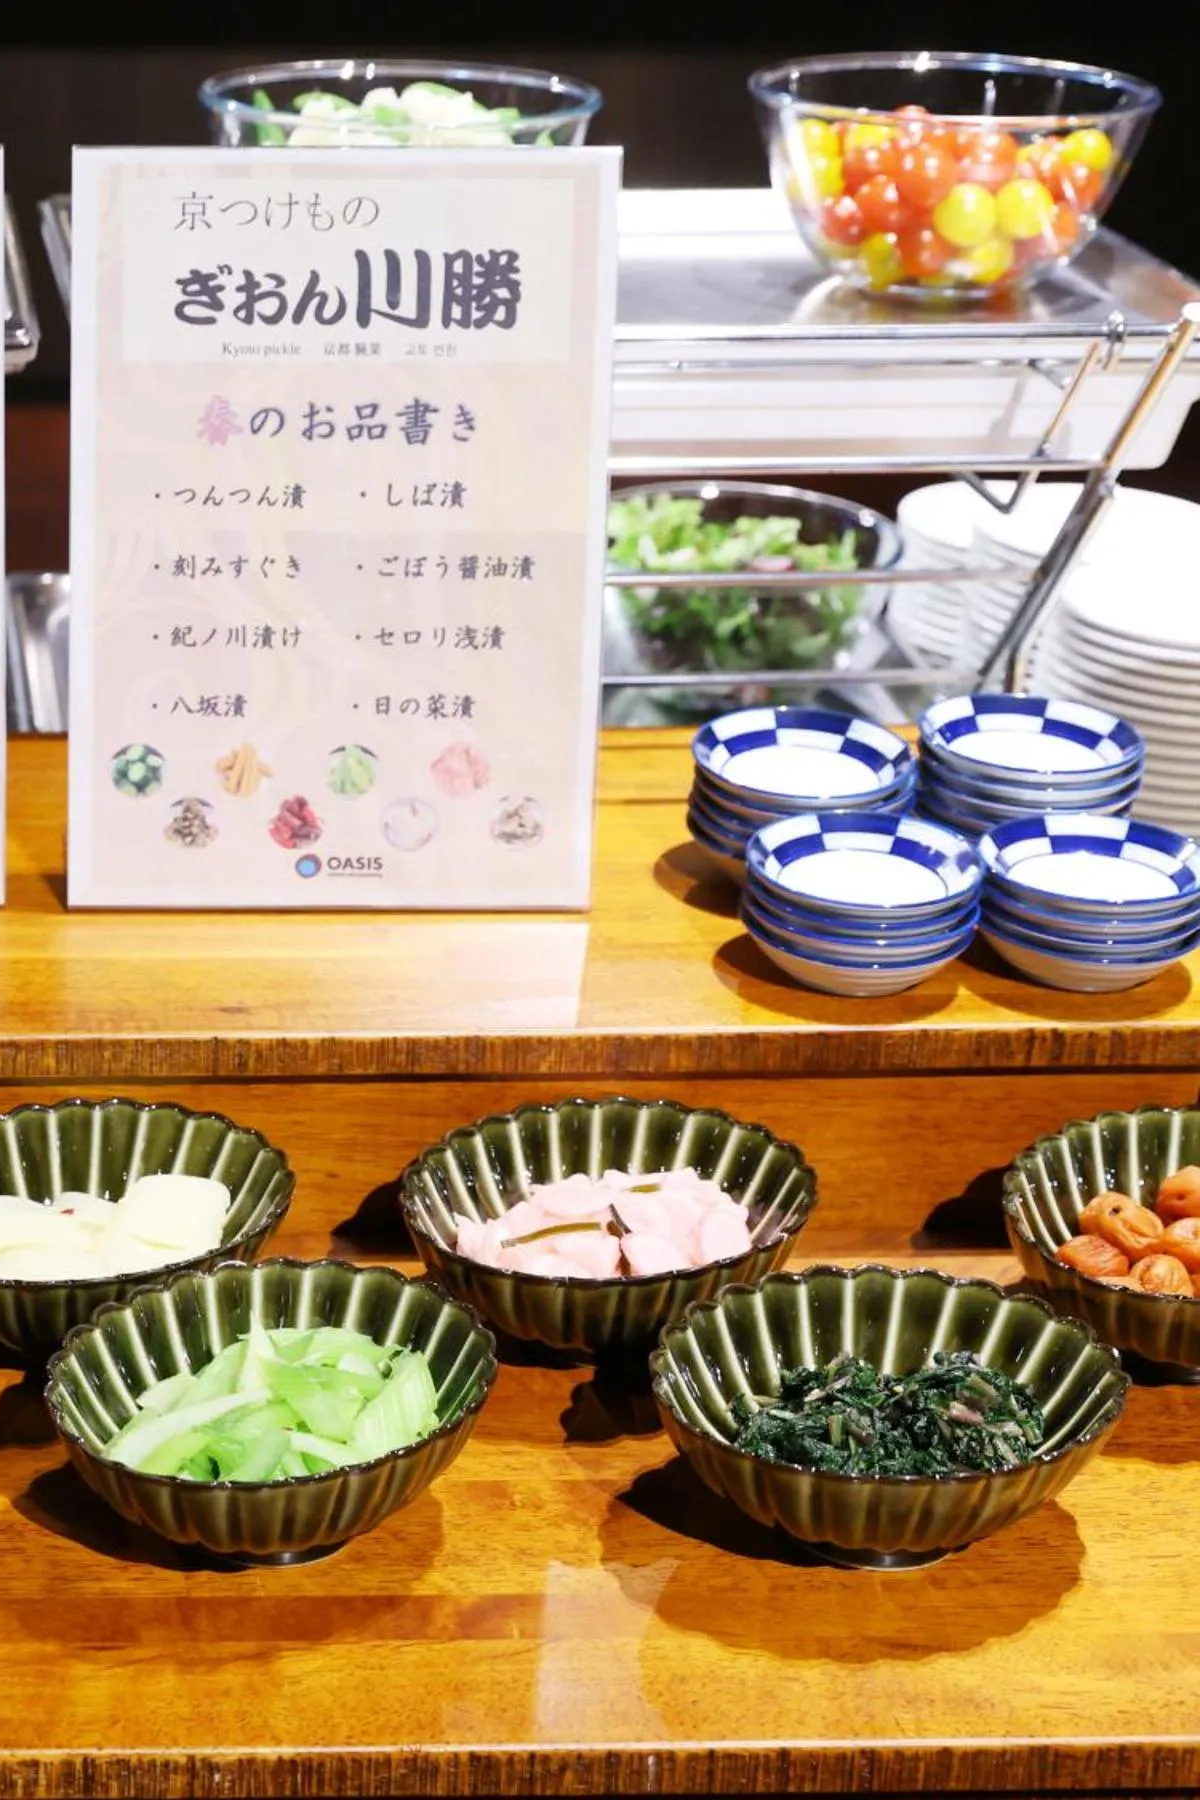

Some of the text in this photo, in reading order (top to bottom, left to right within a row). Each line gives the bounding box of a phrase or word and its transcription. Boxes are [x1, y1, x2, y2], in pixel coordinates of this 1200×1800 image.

[174, 191, 380, 231] 京つけもの
[173, 248, 522, 330] ぎおん川勝
[221, 342, 302, 360] Kyoto pickle
[197, 396, 480, 446] 春のお品書き
[326, 856, 383, 871] OASIS
